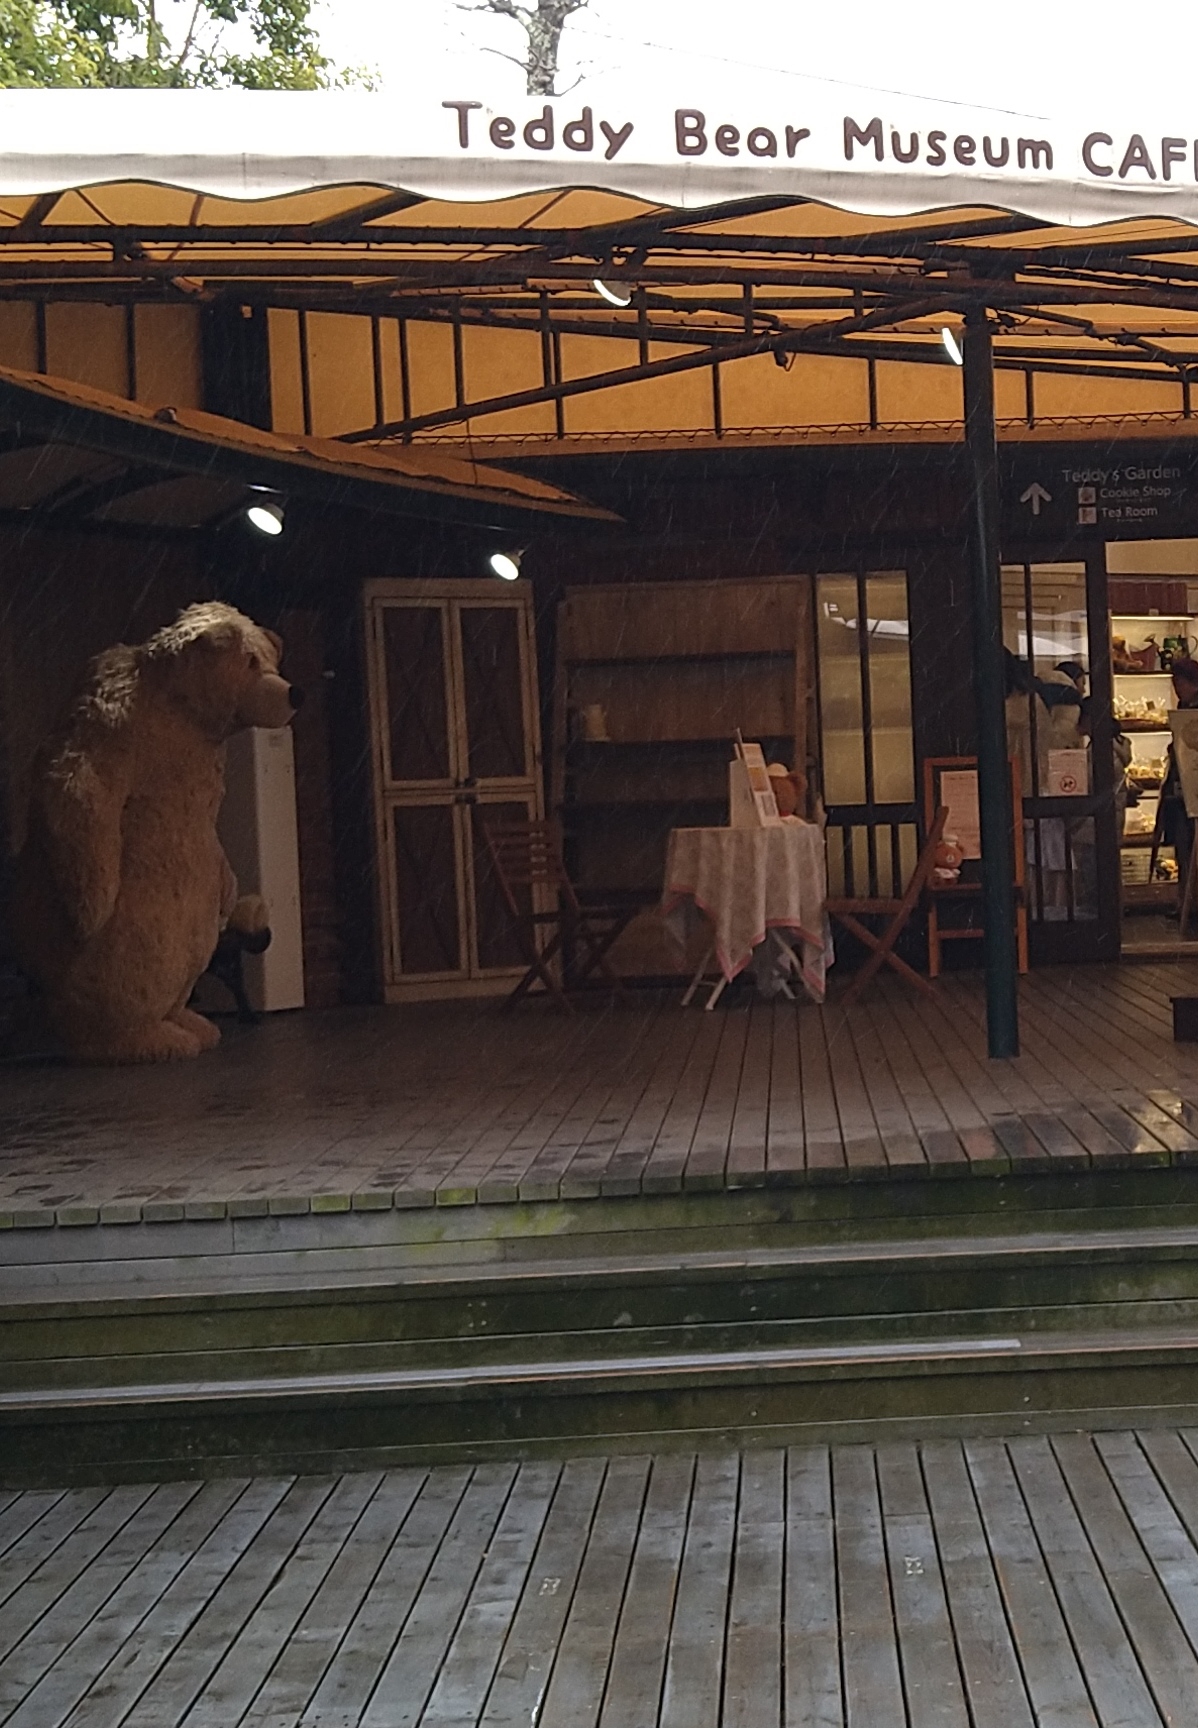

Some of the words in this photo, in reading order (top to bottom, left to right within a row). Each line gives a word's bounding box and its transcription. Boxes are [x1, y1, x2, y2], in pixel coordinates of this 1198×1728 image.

[442, 101, 633, 161] Teddy
[675, 108, 811, 158] Bear
[843, 116, 1055, 171] Museum
[1125, 465, 1180, 480] Garden
[1100, 487, 1140, 499] Cookie
[1143, 485, 1171, 497] Shop
[1101, 507, 1122, 518] Tea
[1125, 506, 1158, 518] Room
